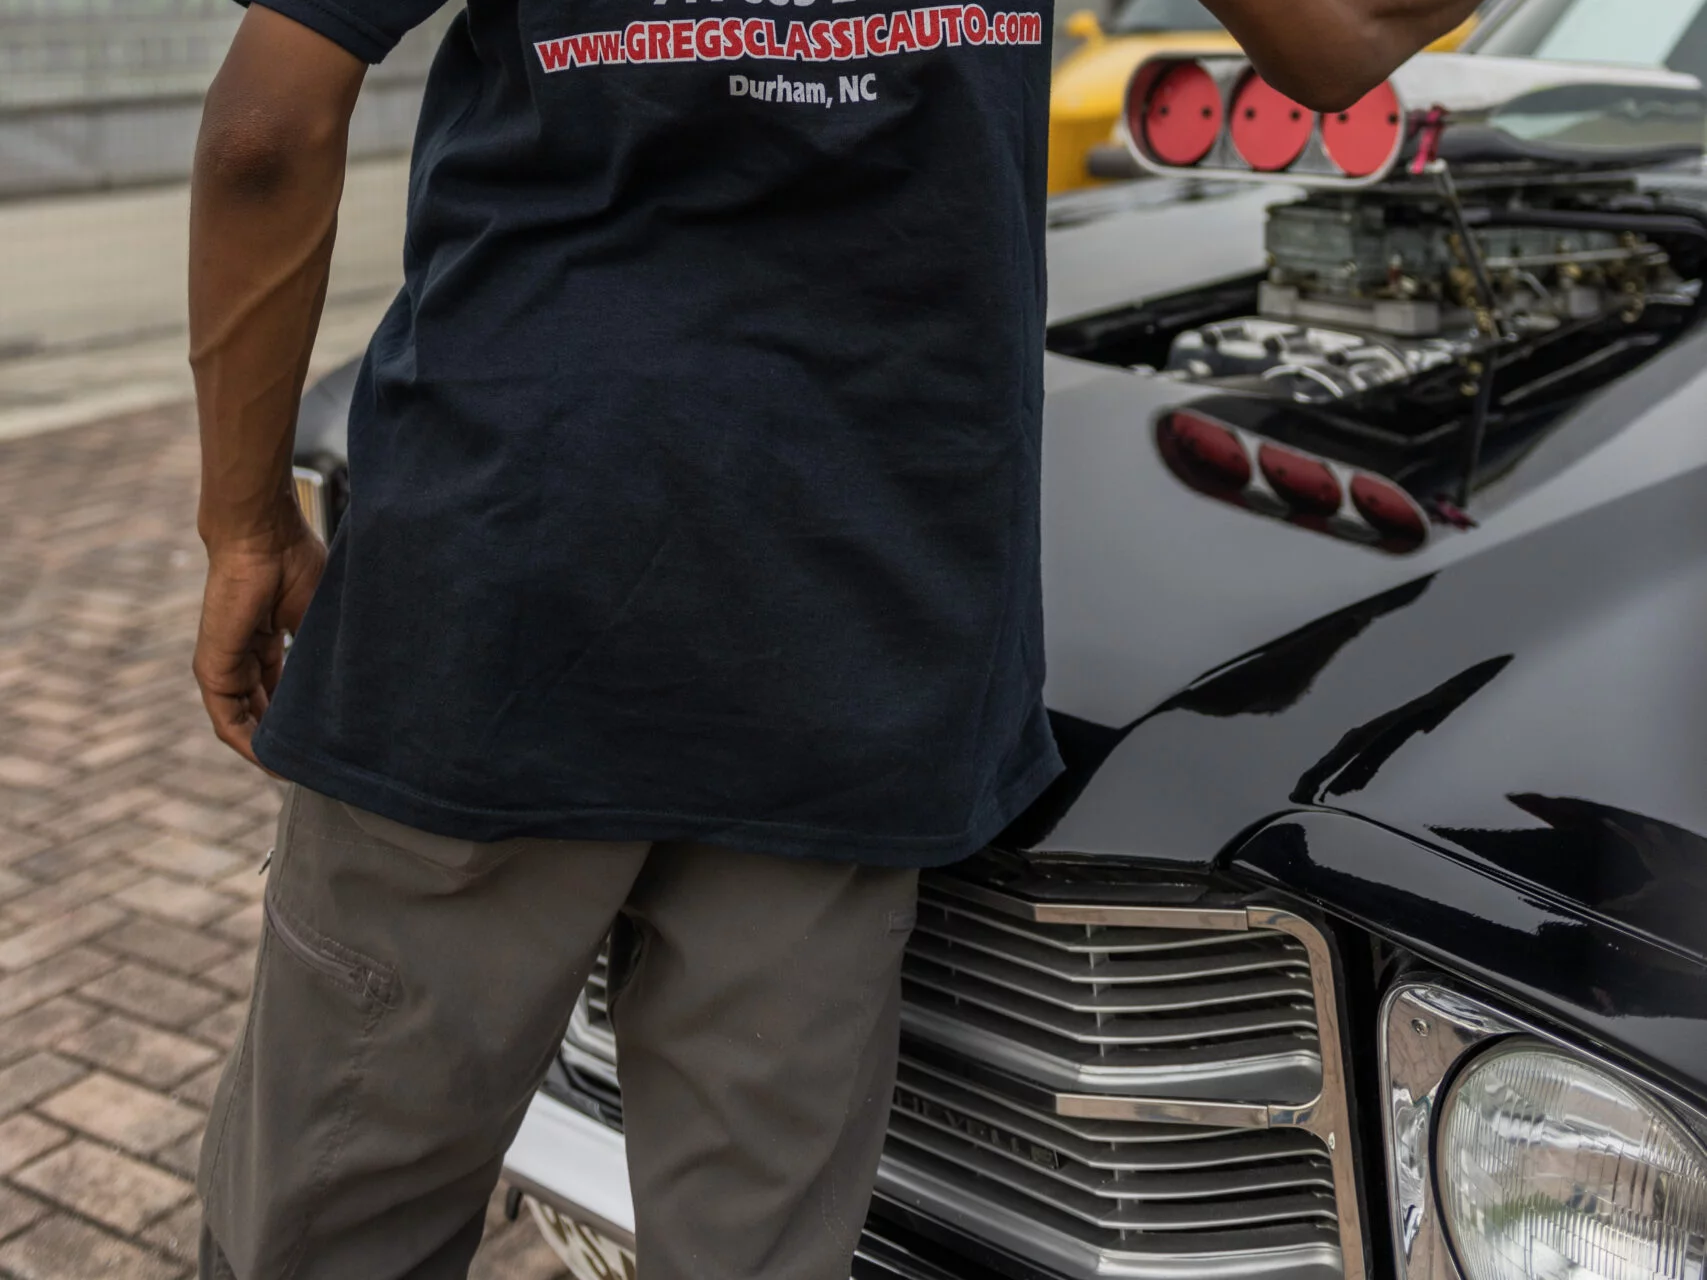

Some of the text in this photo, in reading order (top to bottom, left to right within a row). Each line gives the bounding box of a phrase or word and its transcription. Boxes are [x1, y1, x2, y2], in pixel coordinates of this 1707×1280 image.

[533, 4, 1042, 73] www.GREGSCLASSICAUTO.com
[729, 73, 878, 108] Durham, NC
